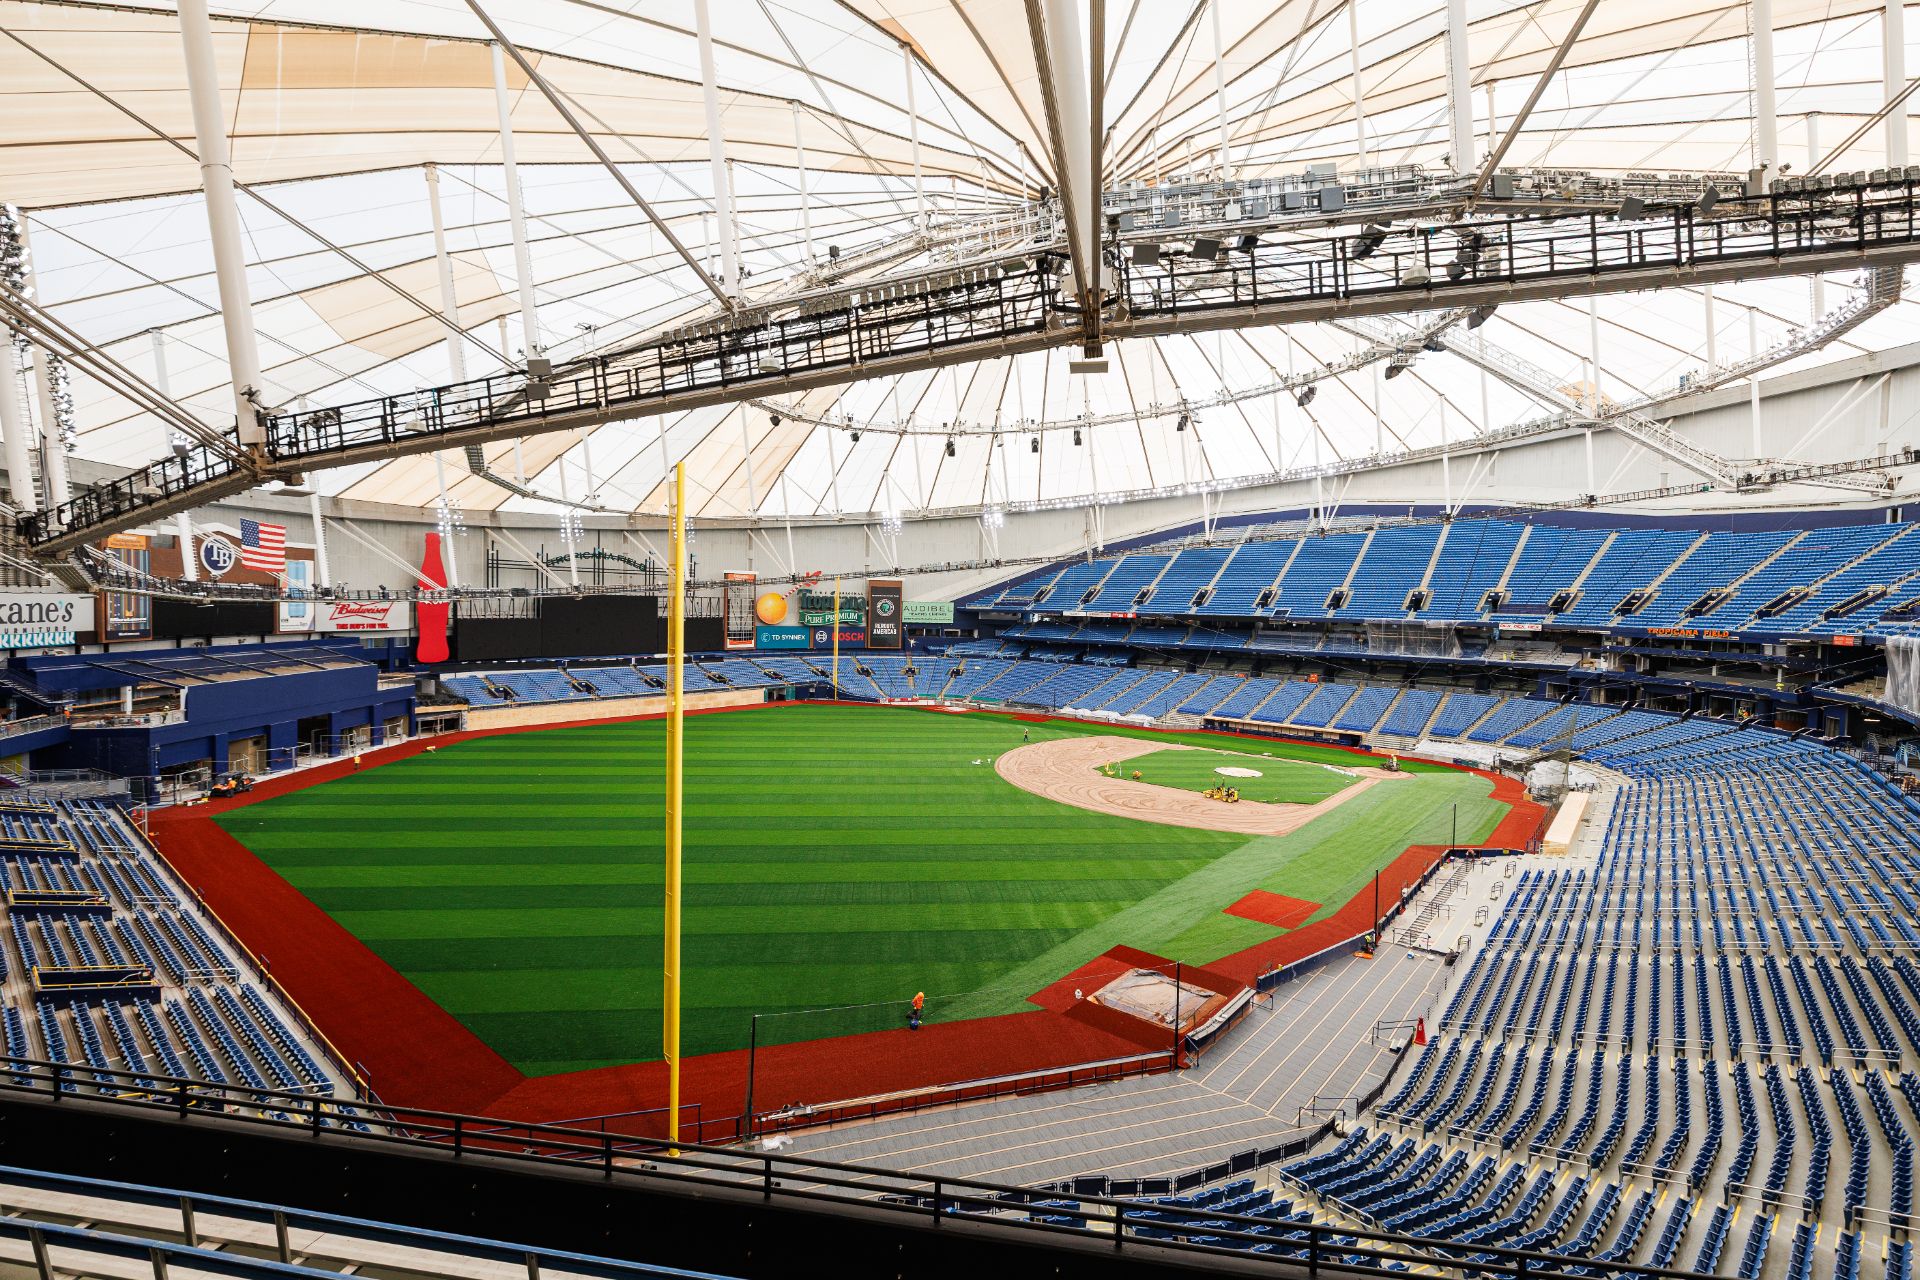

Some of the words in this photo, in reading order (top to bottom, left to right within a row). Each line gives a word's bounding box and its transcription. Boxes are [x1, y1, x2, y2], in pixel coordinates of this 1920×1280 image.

[337, 603, 389, 615] Budweiser
[903, 605, 953, 613] AUDIBEL
[805, 614, 824, 624] PURE
[825, 612, 858, 623] PRMIUM
[1647, 627, 1699, 636] TROPICANA
[1703, 629, 1730, 637] FIELD
